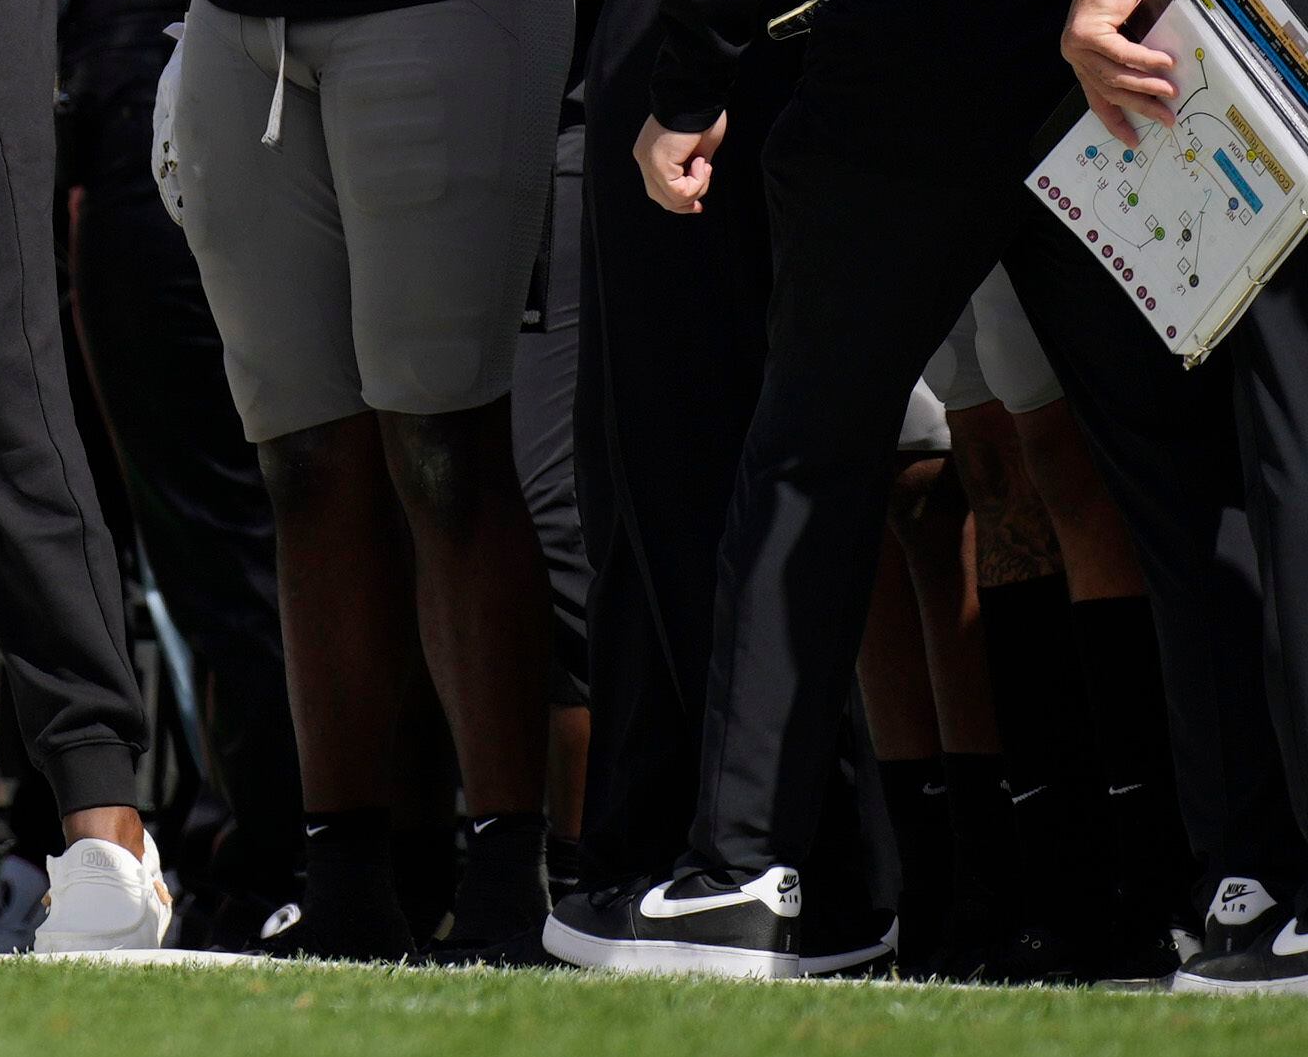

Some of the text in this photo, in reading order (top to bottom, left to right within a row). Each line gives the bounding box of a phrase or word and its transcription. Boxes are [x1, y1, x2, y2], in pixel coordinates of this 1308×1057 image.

[1115, 159, 1127, 173] R2
[1225, 883, 1248, 894] NIKE
[1221, 904, 1247, 913] AIR
